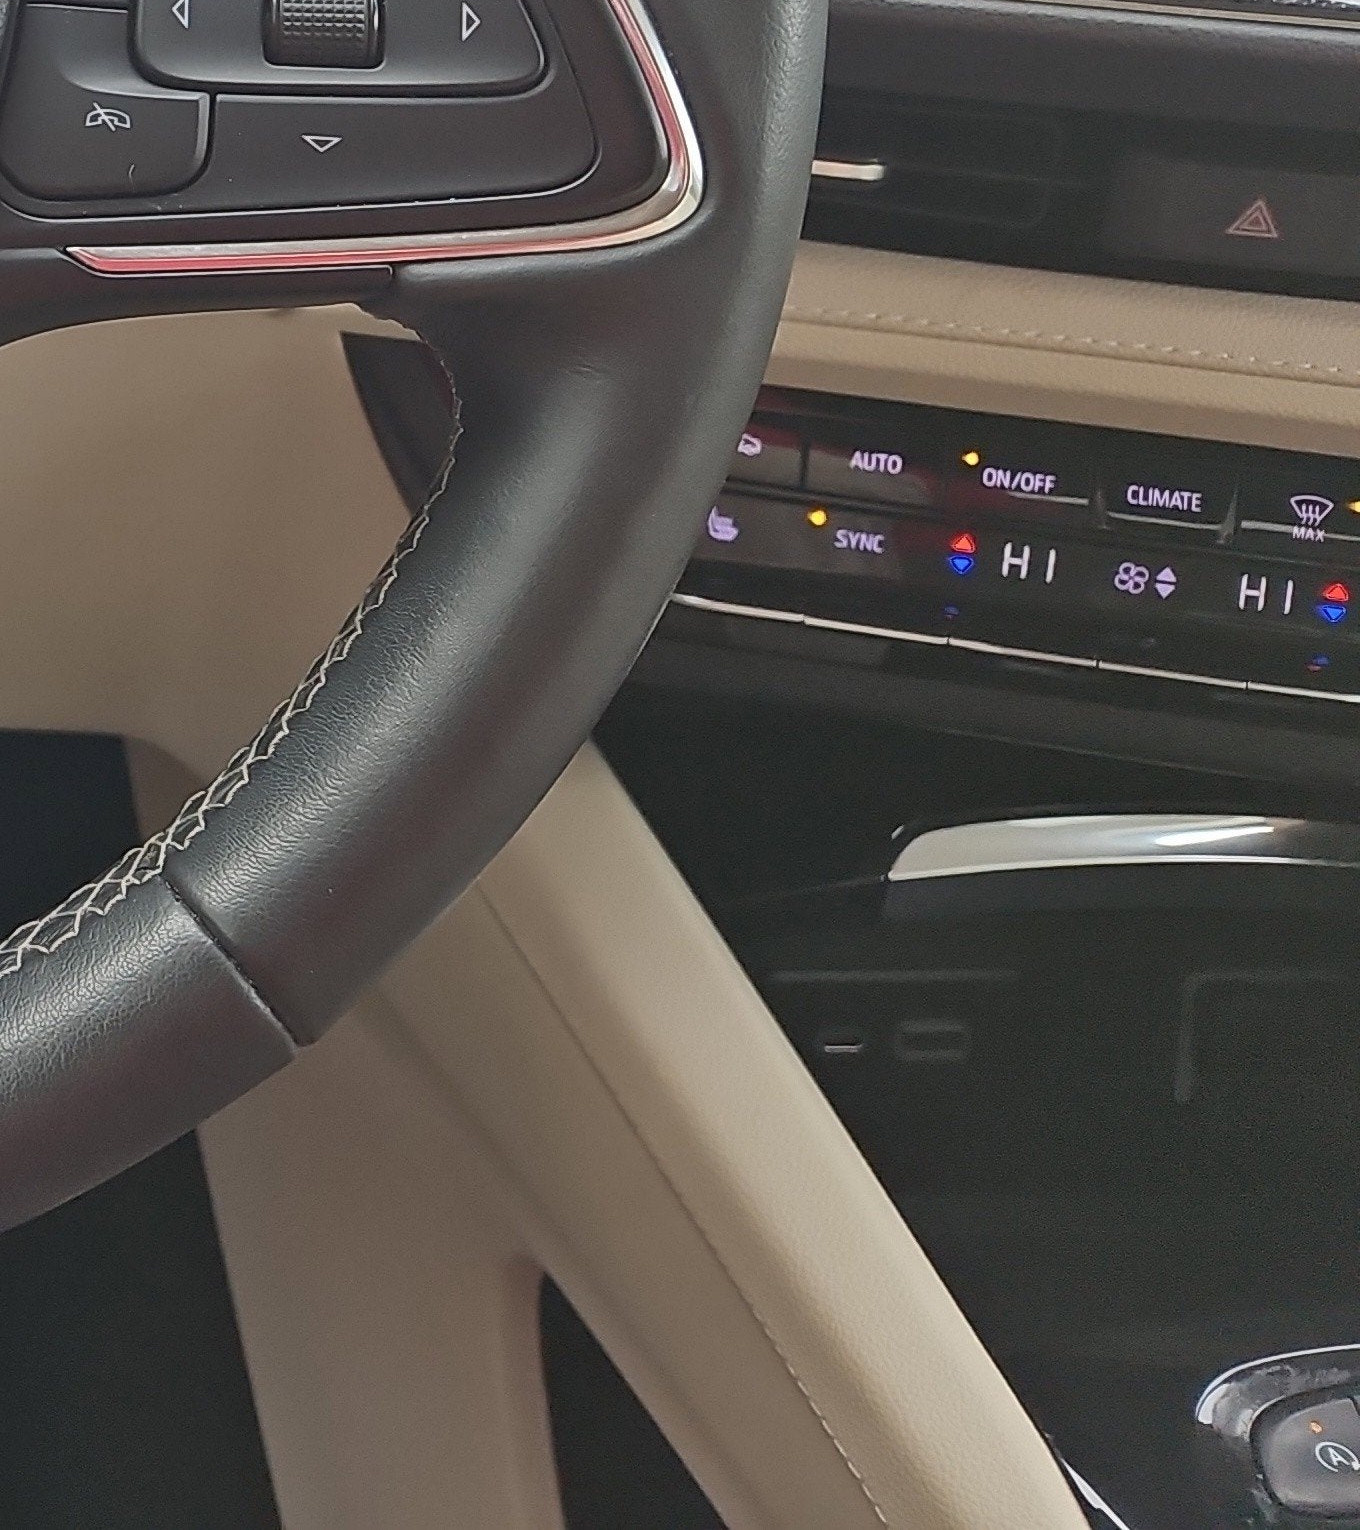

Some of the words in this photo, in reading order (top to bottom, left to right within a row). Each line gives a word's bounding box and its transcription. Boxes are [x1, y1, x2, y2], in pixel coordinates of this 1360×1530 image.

[849, 449, 903, 475] AUTO
[982, 466, 1056, 496] ON/OFF
[1126, 484, 1202, 513] CLIMATE
[833, 529, 885, 554] SYNC
[1292, 525, 1326, 543] MAX
